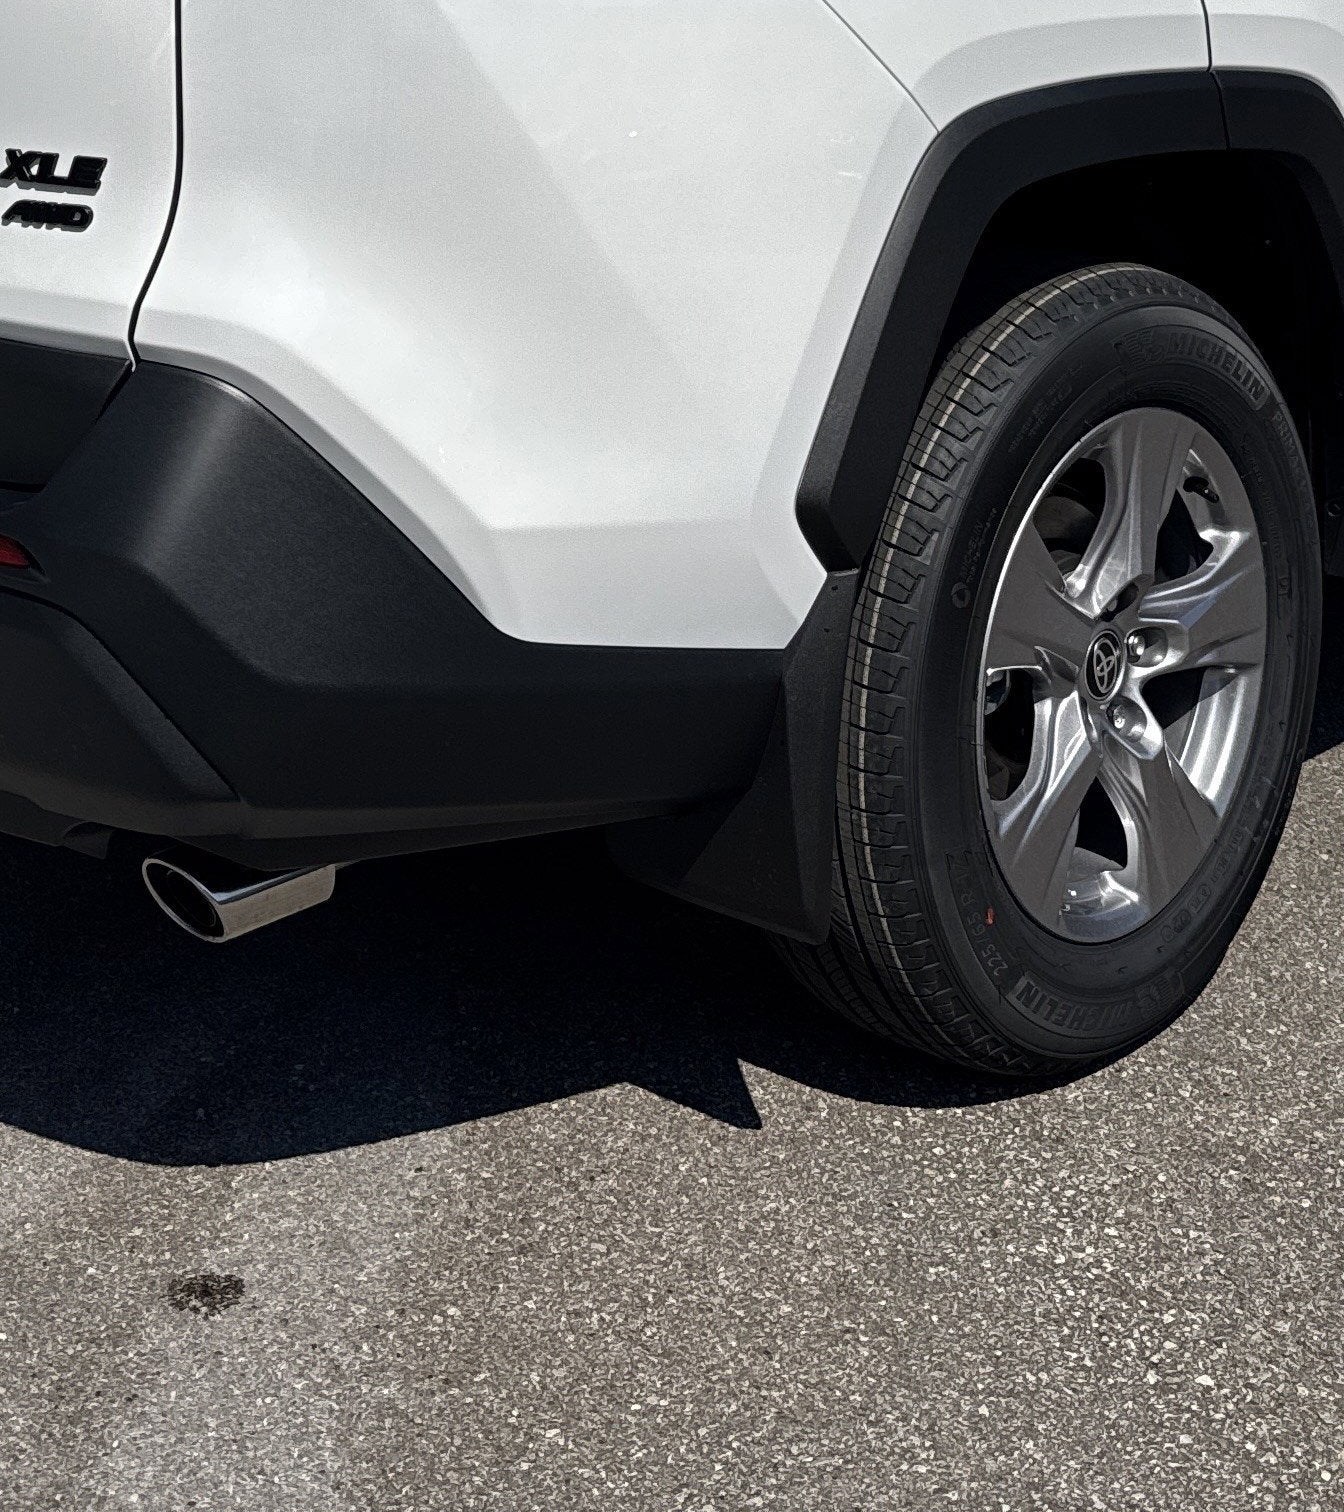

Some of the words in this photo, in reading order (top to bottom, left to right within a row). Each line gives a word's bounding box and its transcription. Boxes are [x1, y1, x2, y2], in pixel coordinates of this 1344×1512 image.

[1167, 332, 1266, 404] MICHELIN
[966, 910, 1009, 977] 225/65
[1015, 978, 1134, 1032] MICHELIN
